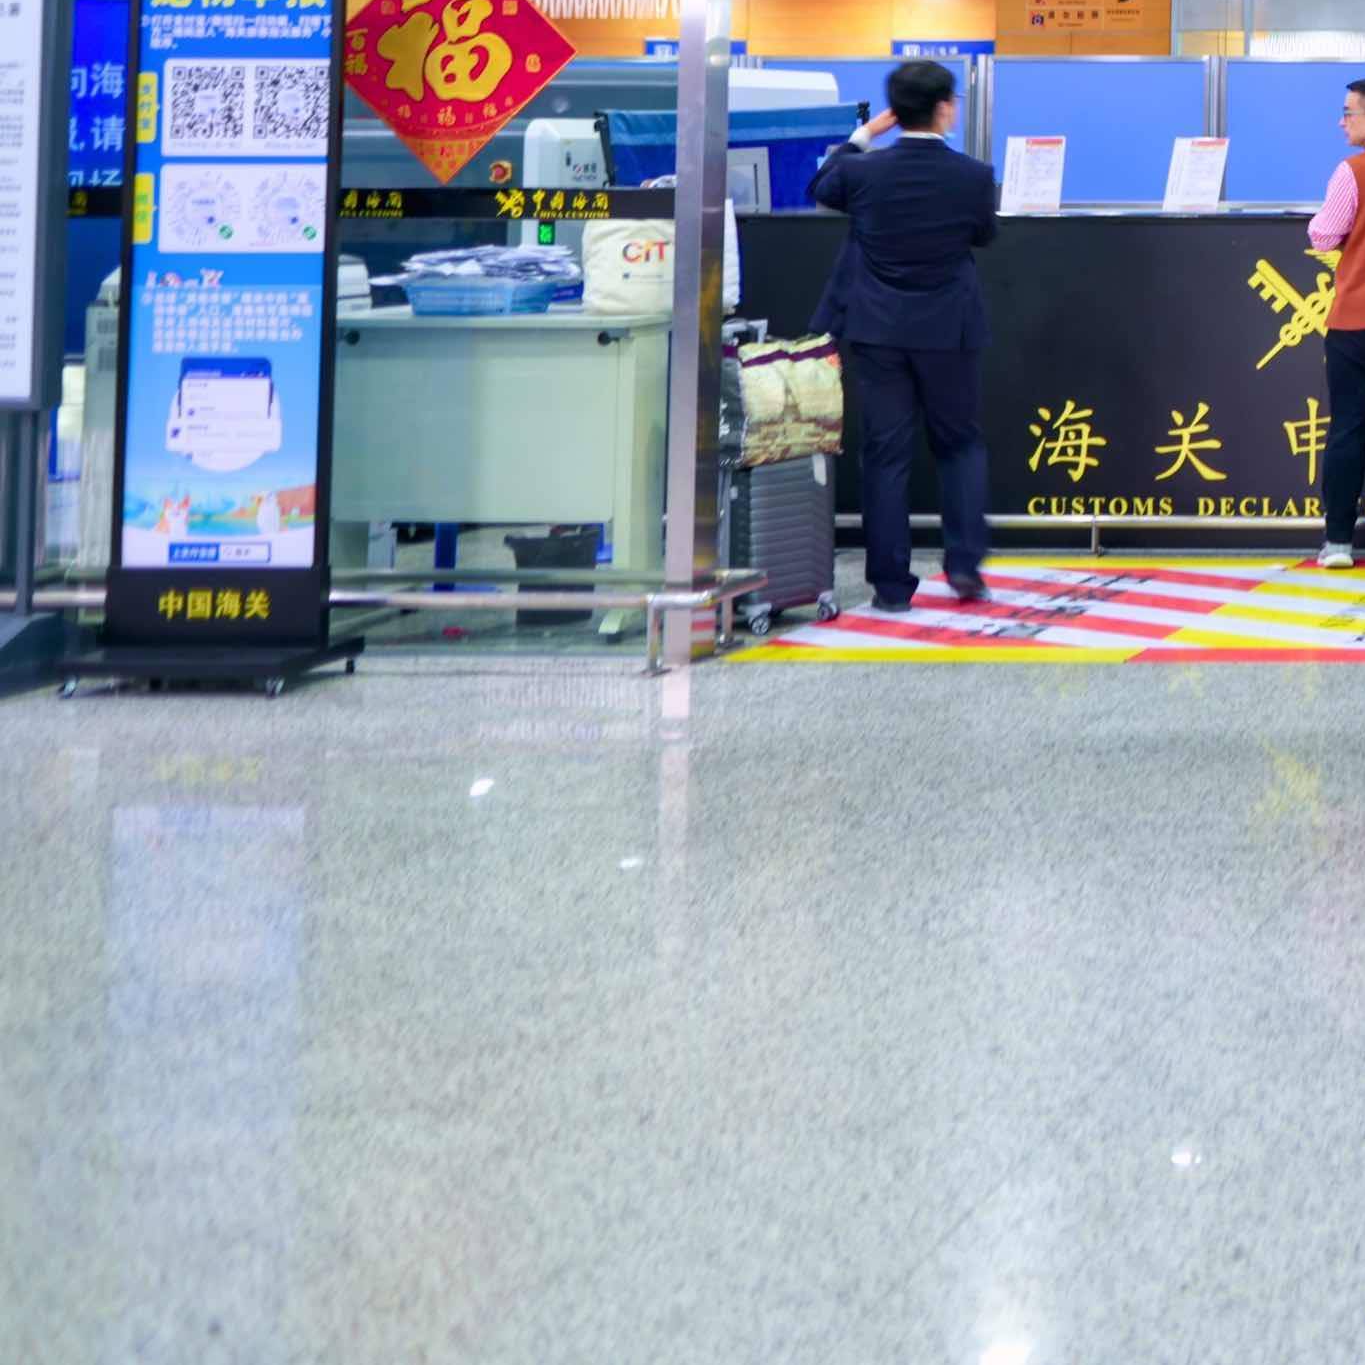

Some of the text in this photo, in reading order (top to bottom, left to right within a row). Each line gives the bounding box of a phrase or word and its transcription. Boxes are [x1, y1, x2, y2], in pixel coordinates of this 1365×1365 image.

[1027, 496, 1173, 517] CUSTOMS
[158, 588, 271, 620] 中国海关
